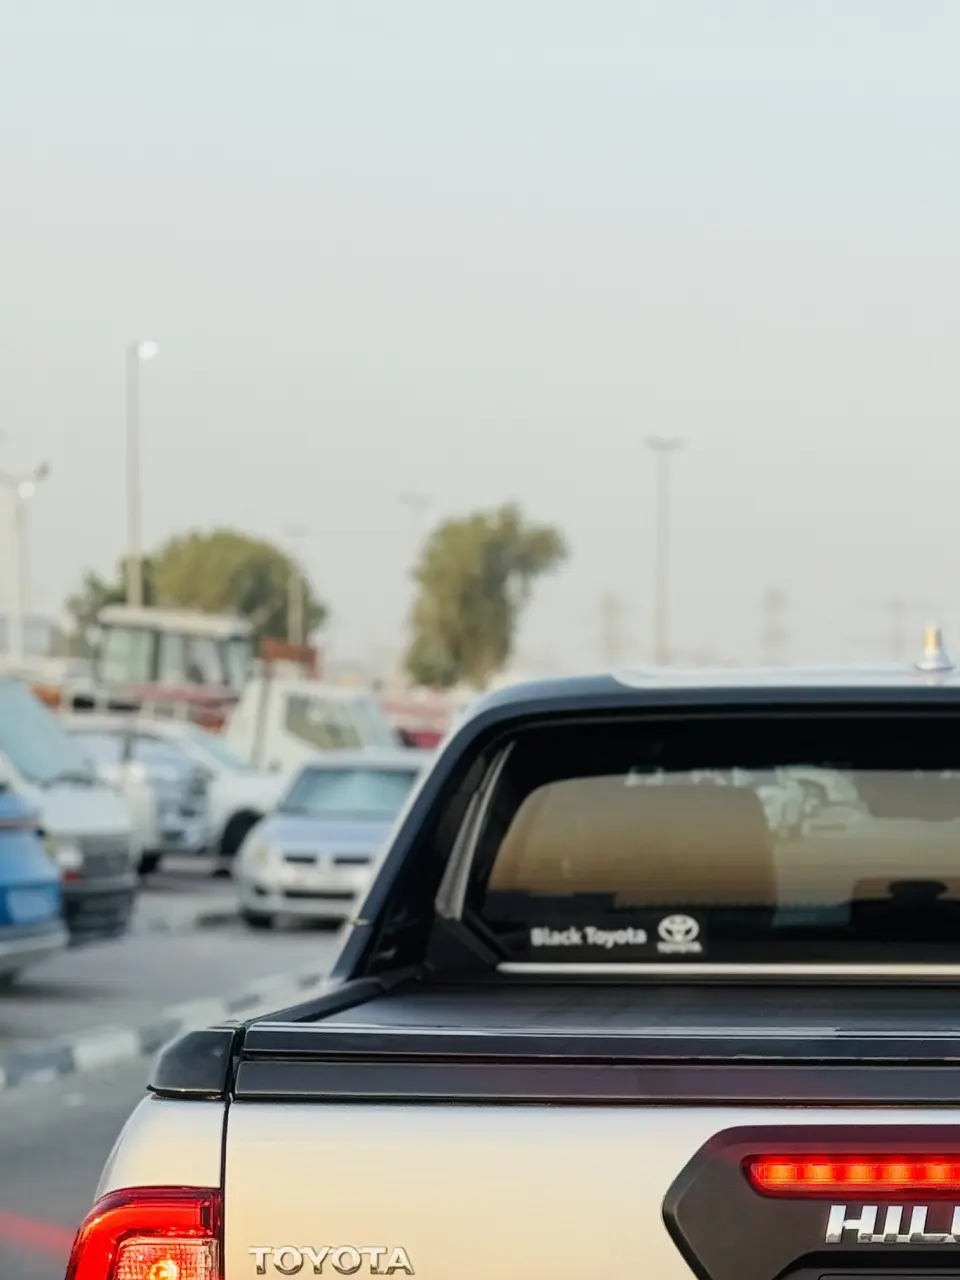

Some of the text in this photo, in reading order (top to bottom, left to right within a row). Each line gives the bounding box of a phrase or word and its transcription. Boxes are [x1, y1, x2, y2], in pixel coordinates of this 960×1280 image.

[531, 926, 647, 949] Black Toyota
[249, 1246, 415, 1275] TOYOTA
